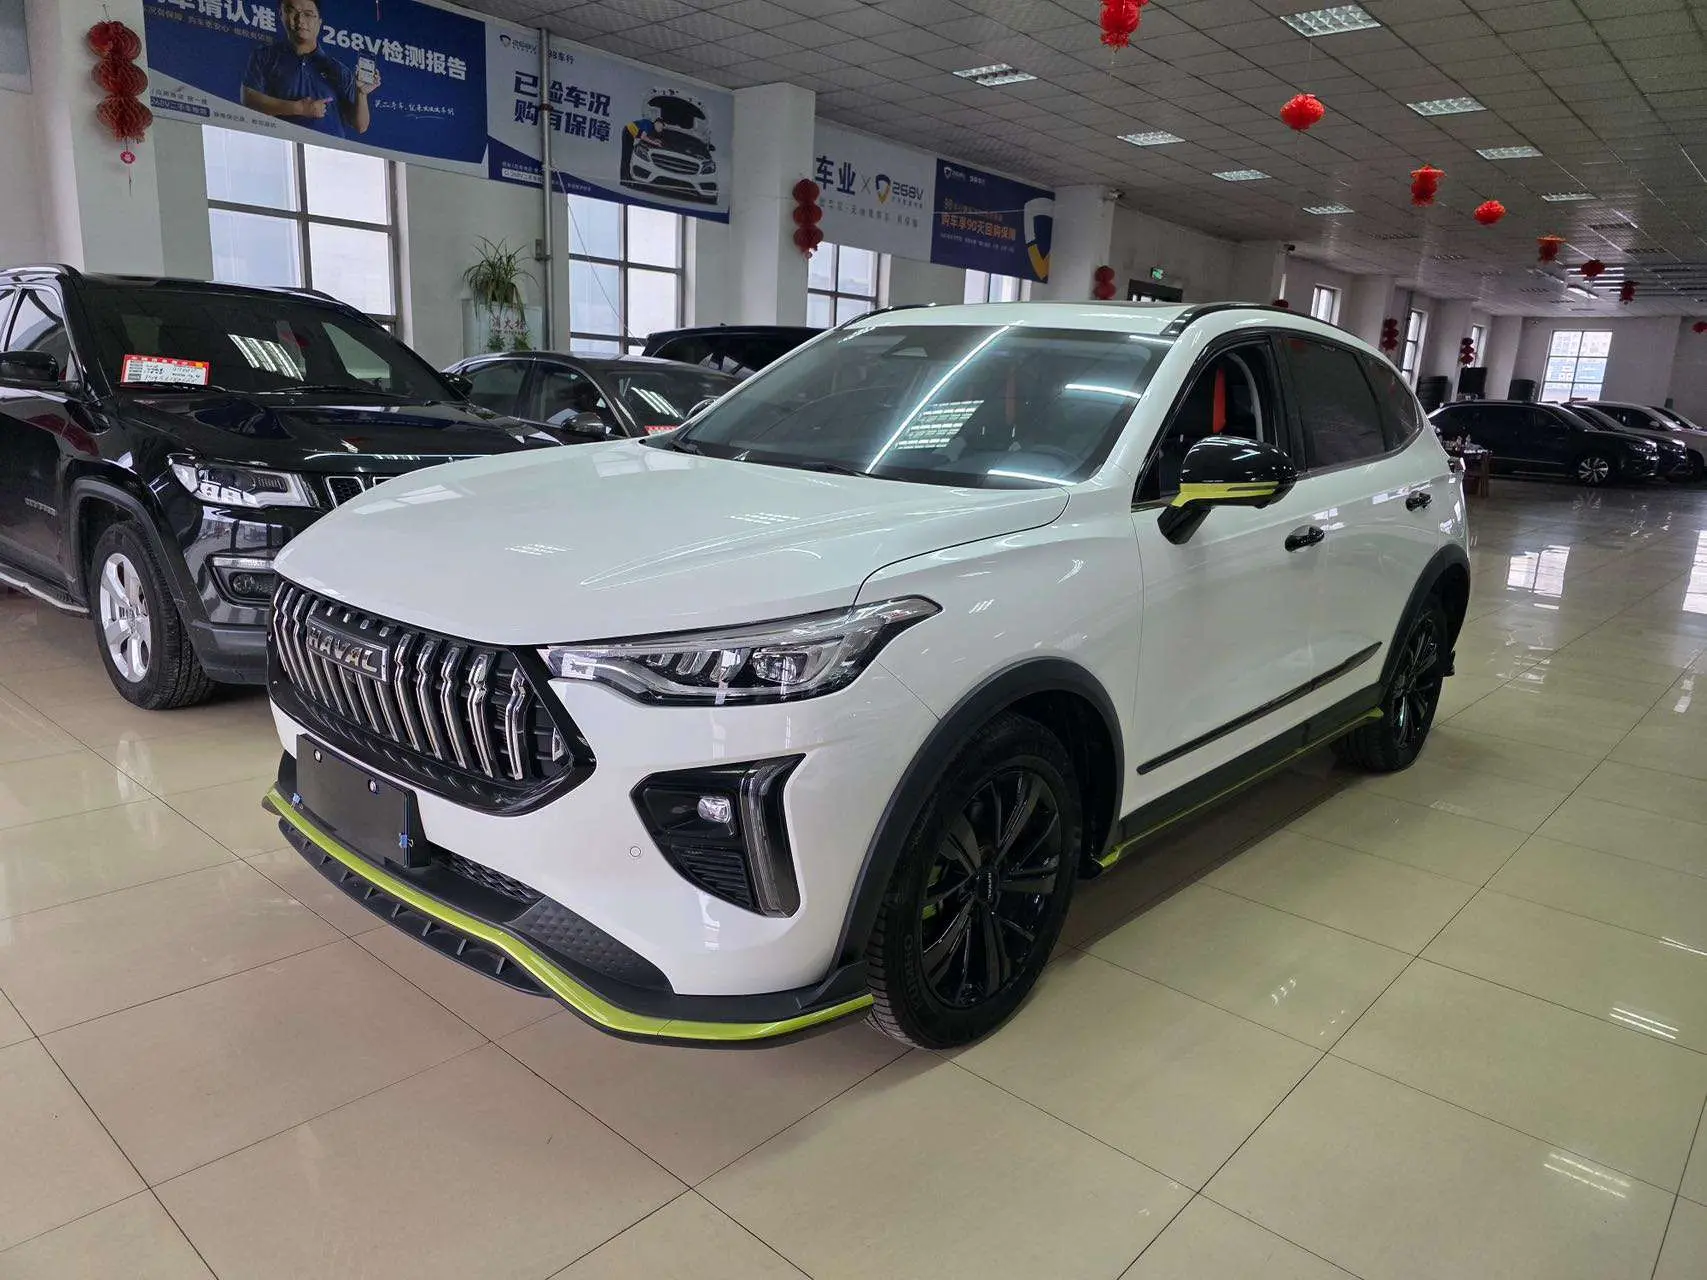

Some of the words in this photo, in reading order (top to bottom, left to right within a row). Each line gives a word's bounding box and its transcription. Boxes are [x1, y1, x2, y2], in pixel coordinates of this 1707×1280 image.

[322, 25, 467, 81] 268V检测报告
[892, 180, 924, 201] 268V
